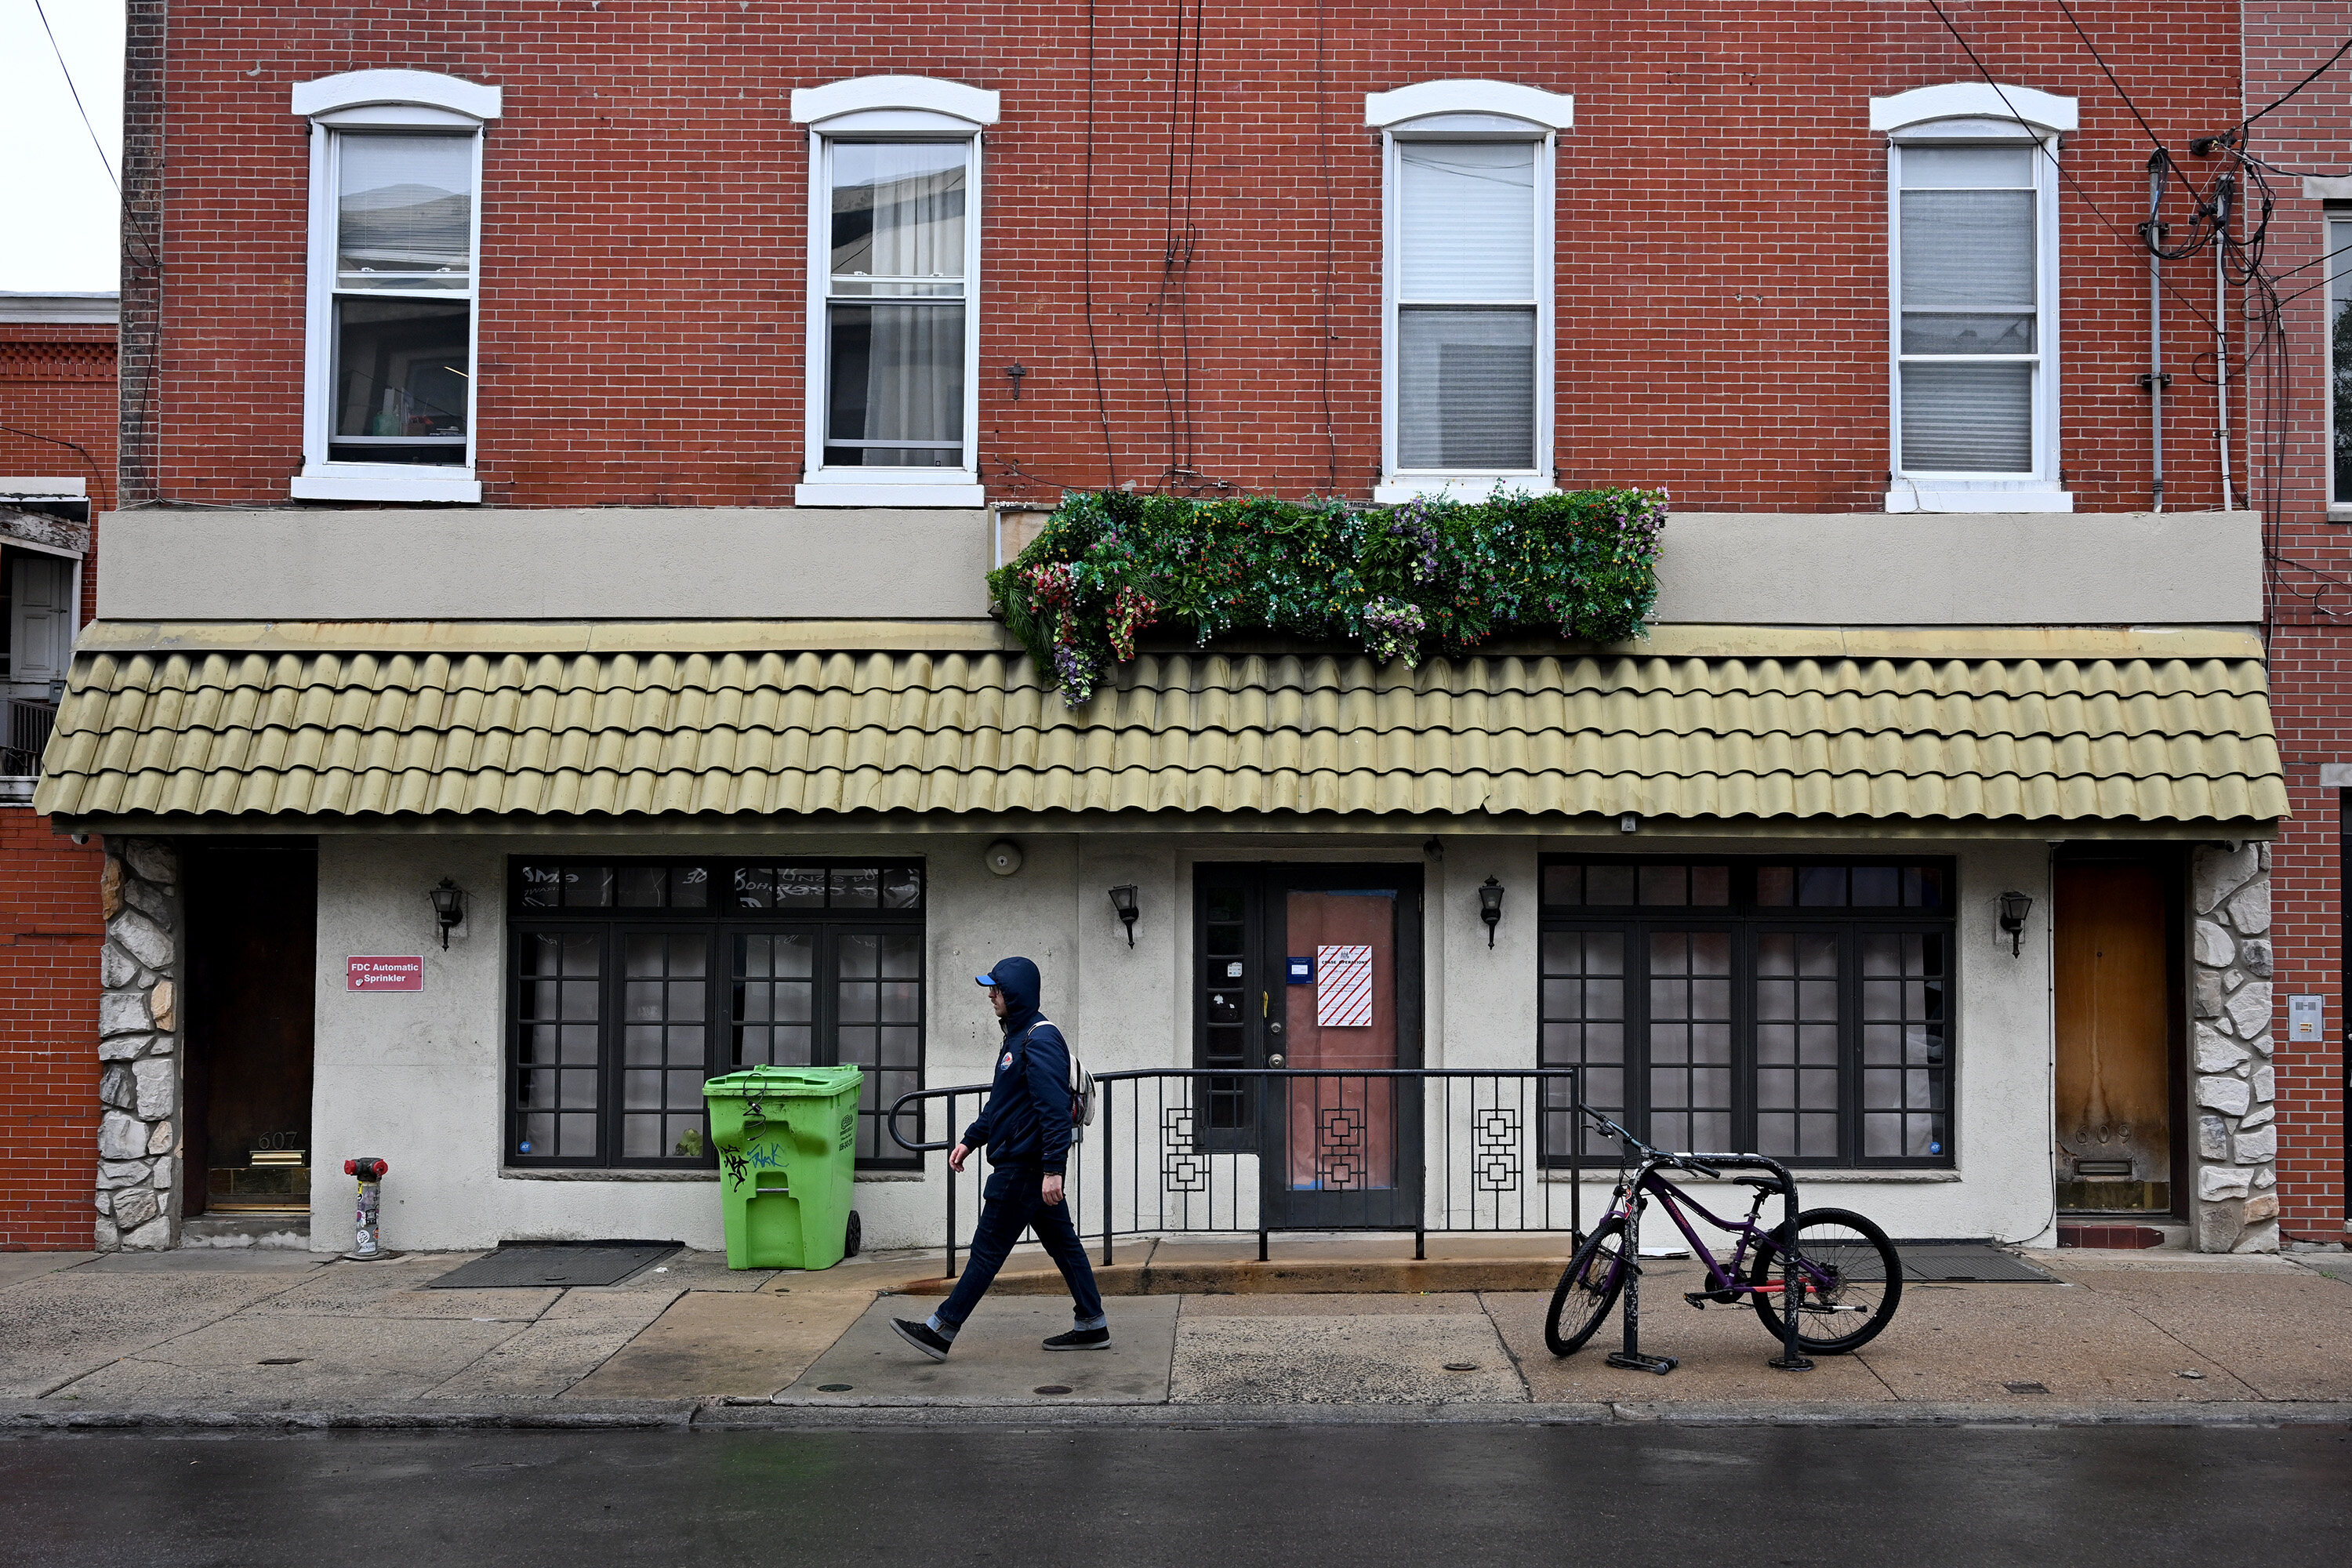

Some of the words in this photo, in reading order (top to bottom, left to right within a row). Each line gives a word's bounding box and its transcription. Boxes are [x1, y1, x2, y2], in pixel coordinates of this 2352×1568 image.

[364, 974, 406, 983] Sprinkler
[259, 1131, 298, 1150] 607
[2075, 1124, 2132, 1144] 609
